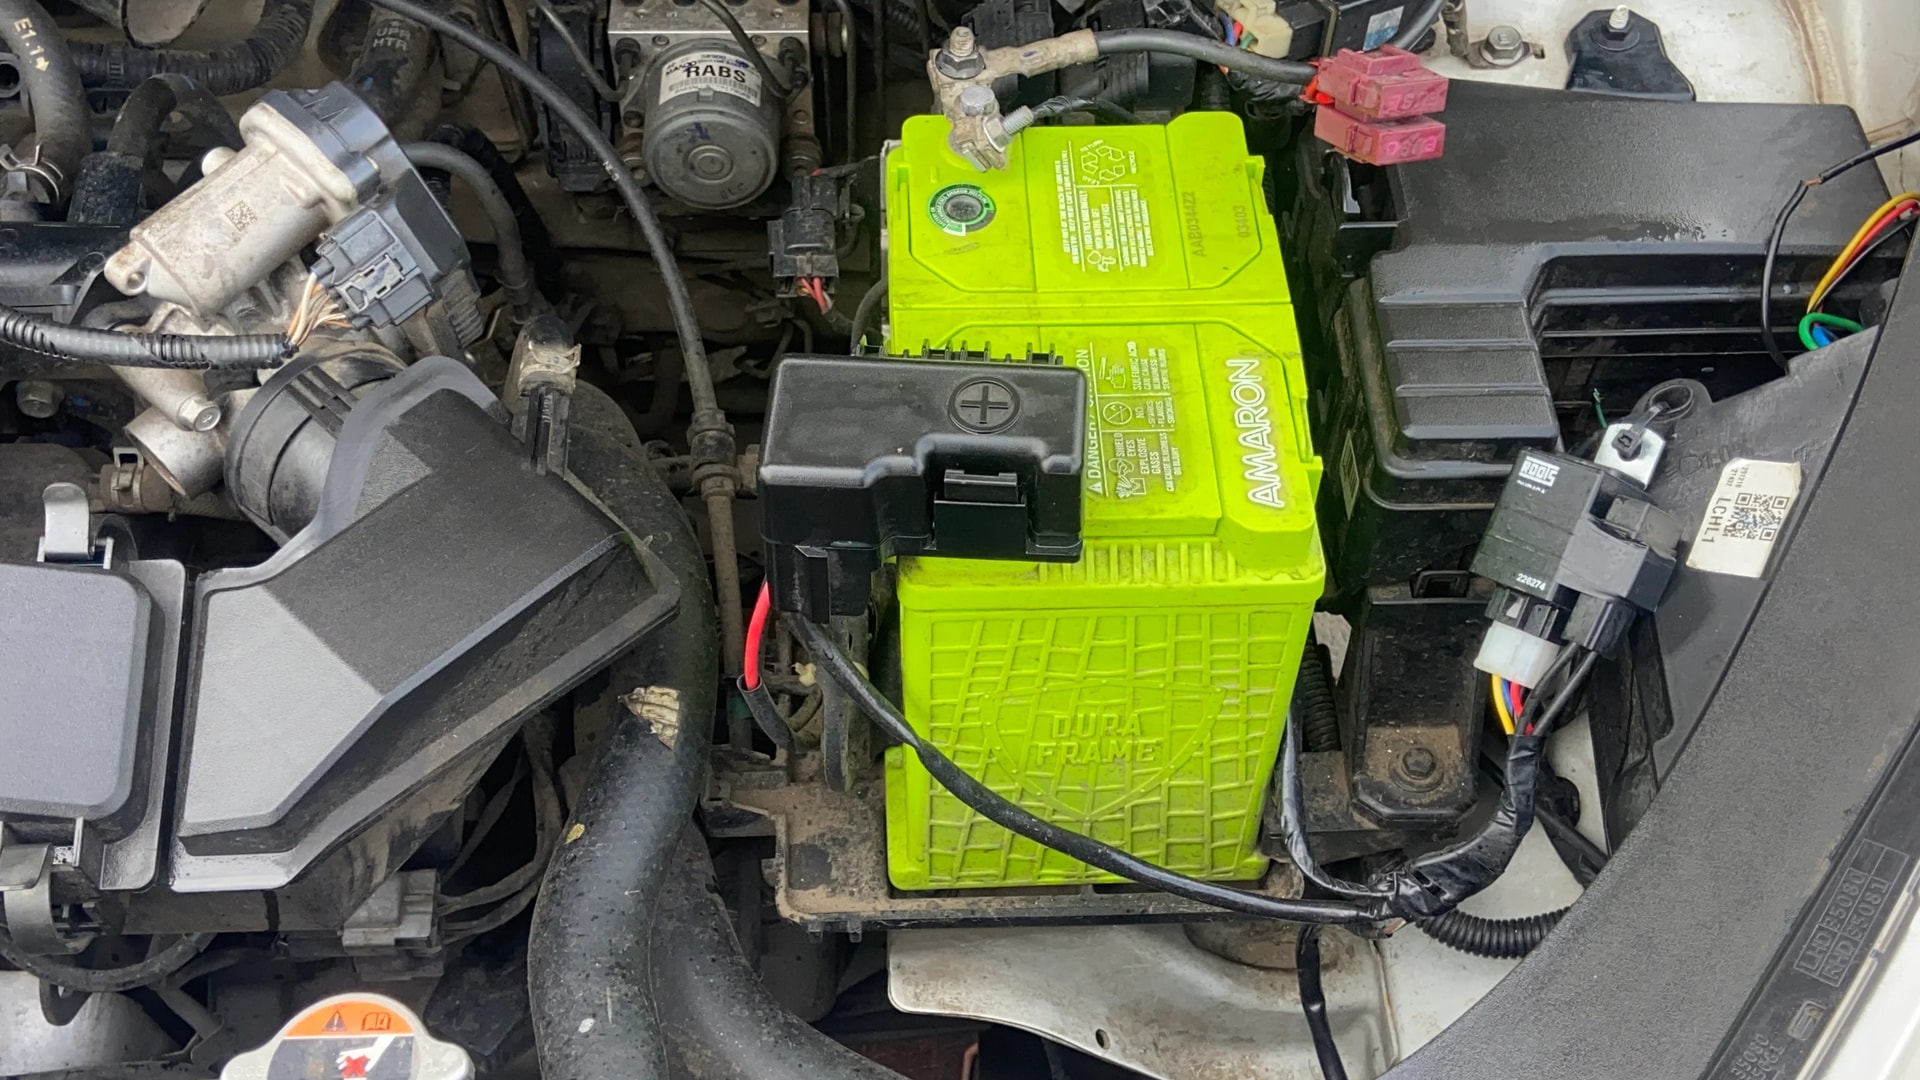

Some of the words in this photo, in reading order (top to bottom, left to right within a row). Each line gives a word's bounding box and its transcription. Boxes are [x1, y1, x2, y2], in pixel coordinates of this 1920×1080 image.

[684, 64, 747, 84] RABS
[1134, 406, 1144, 418] NO
[1112, 432, 1125, 456] SHIELD
[1225, 359, 1285, 508] AMARON
[1124, 439, 1136, 456] EYES
[1136, 437, 1150, 473] EXPLOSIVE
[1149, 451, 1161, 473] GASES
[1519, 456, 1560, 487] ROOTS
[1701, 497, 1732, 543] LCHL1
[1052, 713, 1142, 738] DURA
[1037, 739, 1158, 766] FRAME
[1800, 930, 1833, 970] LHD
[1822, 940, 1855, 980] RHD
